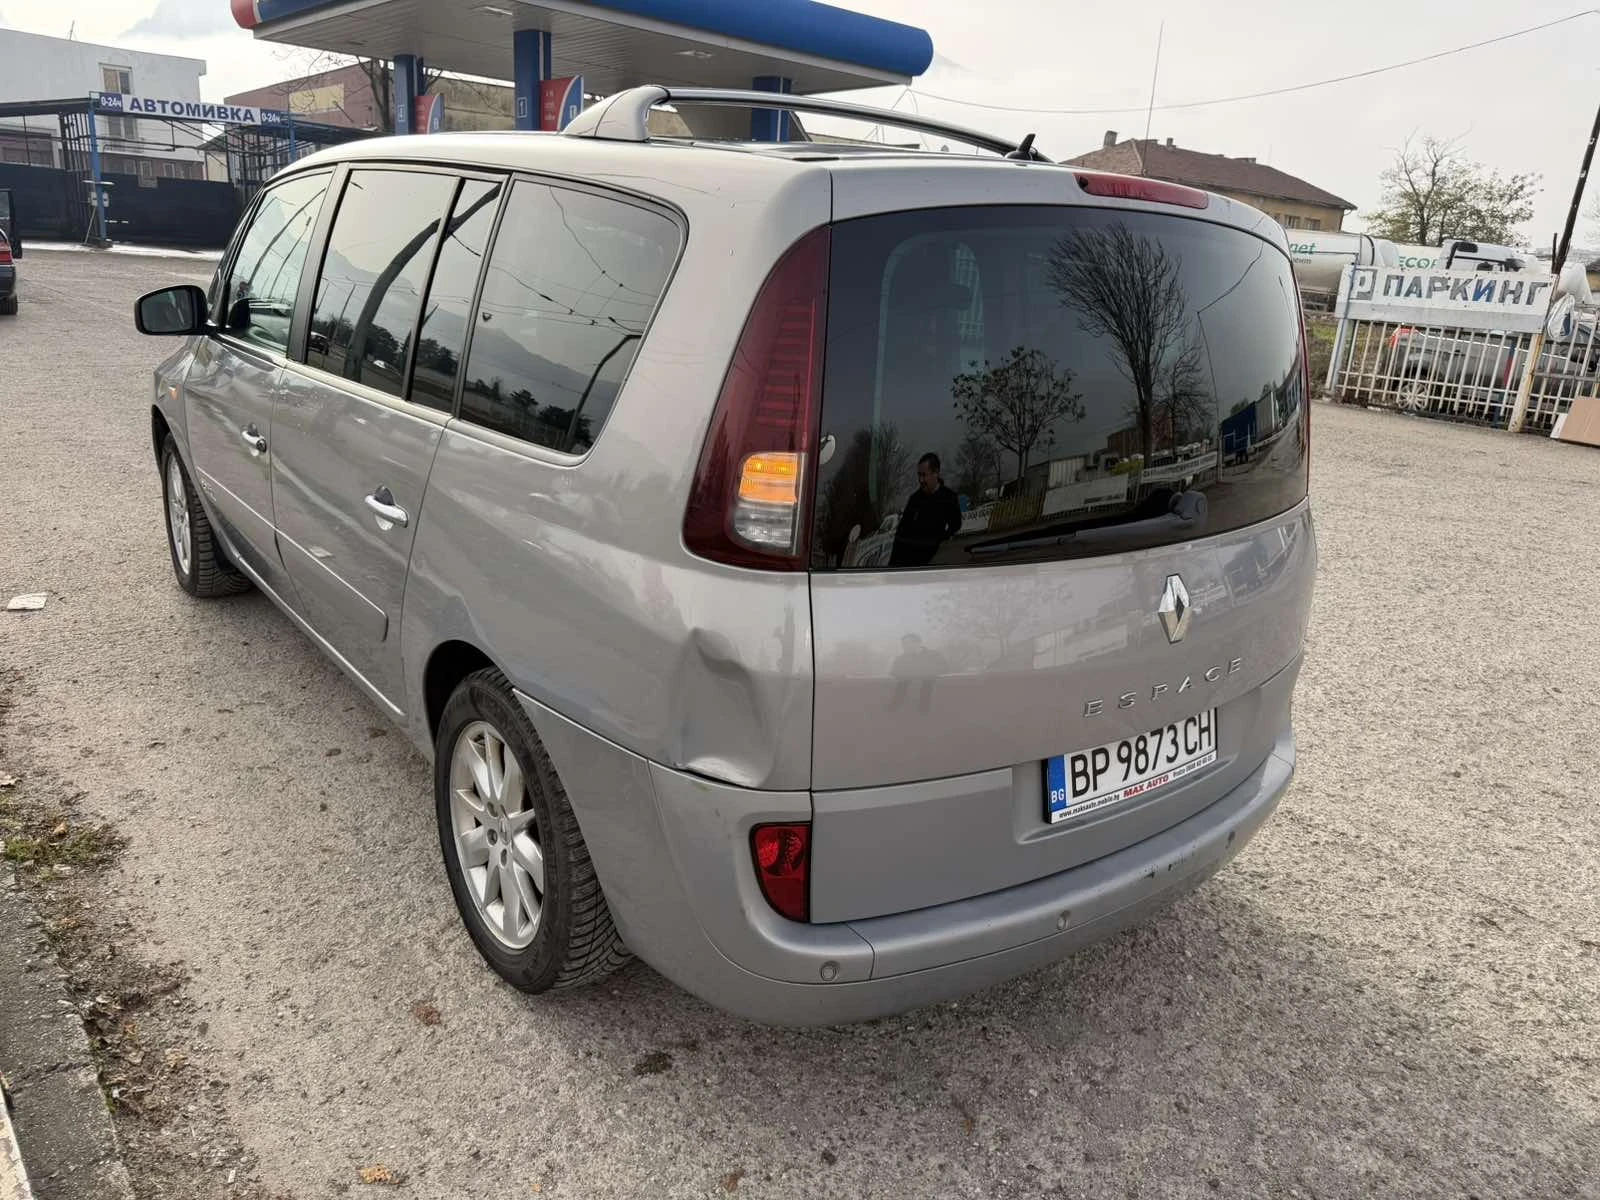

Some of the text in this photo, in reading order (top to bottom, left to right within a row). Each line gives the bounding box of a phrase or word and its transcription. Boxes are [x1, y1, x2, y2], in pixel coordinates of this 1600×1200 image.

[129, 97, 256, 123] АВТОМИВКА
[1383, 274, 1550, 306] ПАРКИНГ
[1083, 657, 1242, 718] ESPACE
[1116, 724, 1179, 782] 9873
[1051, 788, 1065, 803] BG
[1123, 784, 1145, 798] MAX
[1146, 774, 1169, 790] AUTO
